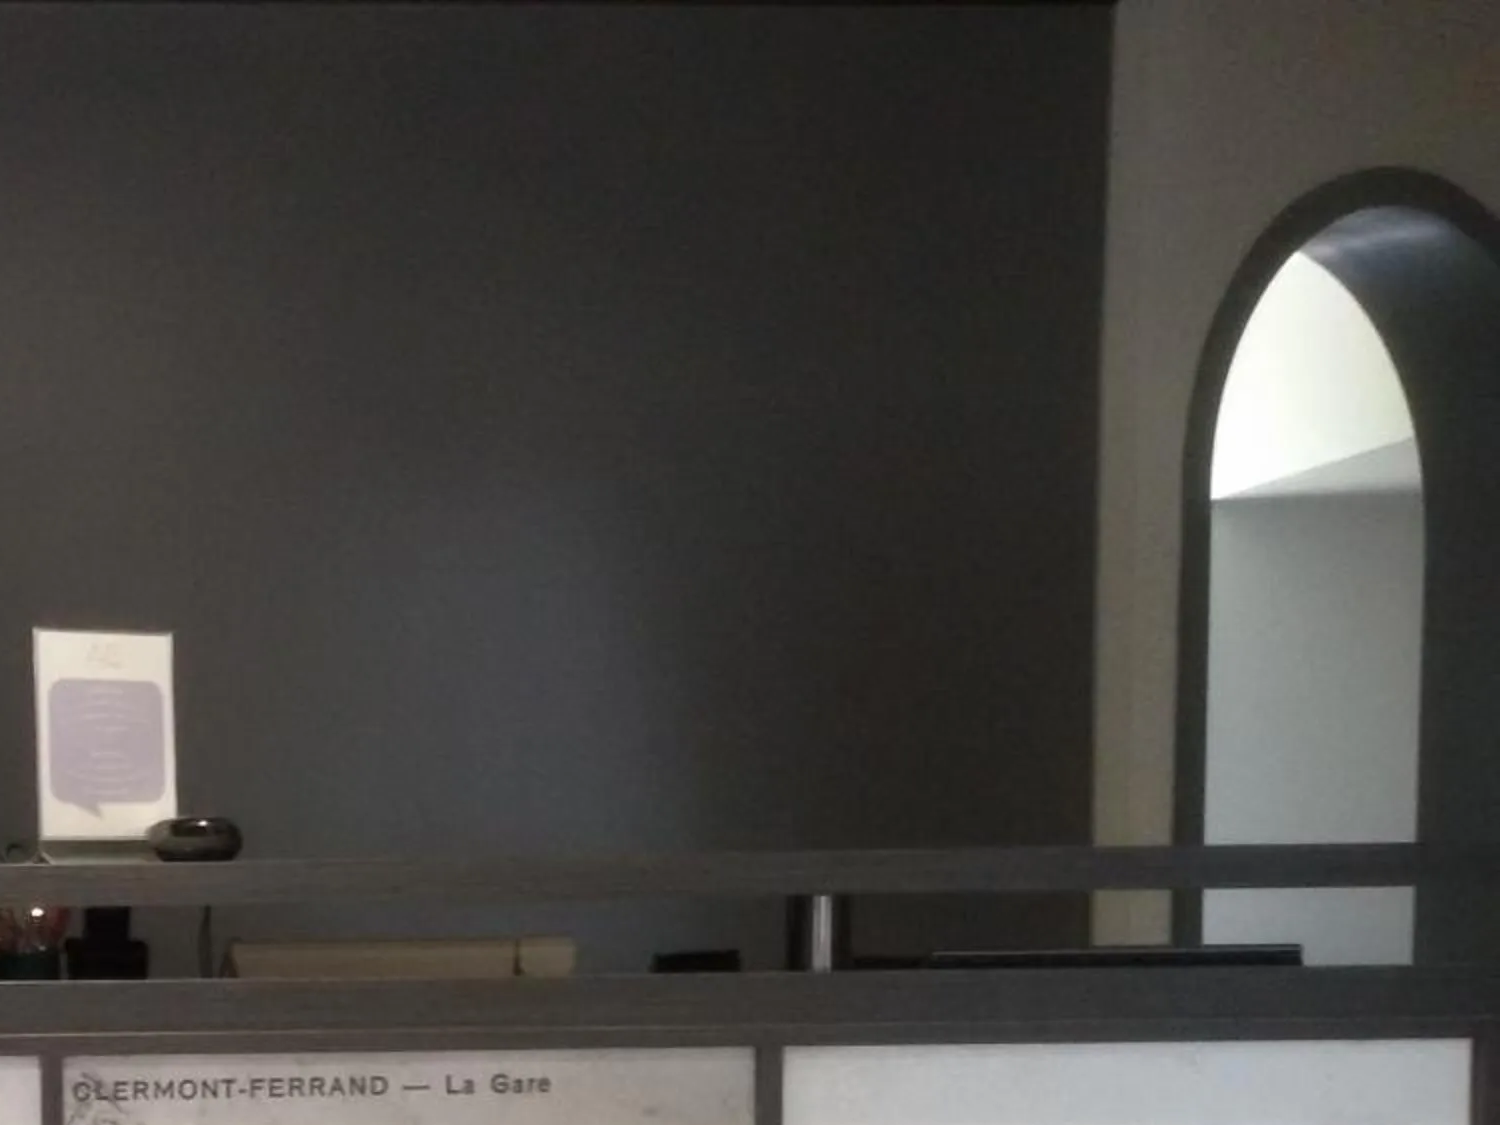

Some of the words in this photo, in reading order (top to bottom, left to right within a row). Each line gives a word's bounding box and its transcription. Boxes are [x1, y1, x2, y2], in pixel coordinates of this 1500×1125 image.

[72, 1075, 390, 1102] CLERMONT-FERRAND
[445, 1073, 475, 1096] La
[490, 1072, 552, 1095] Gare
